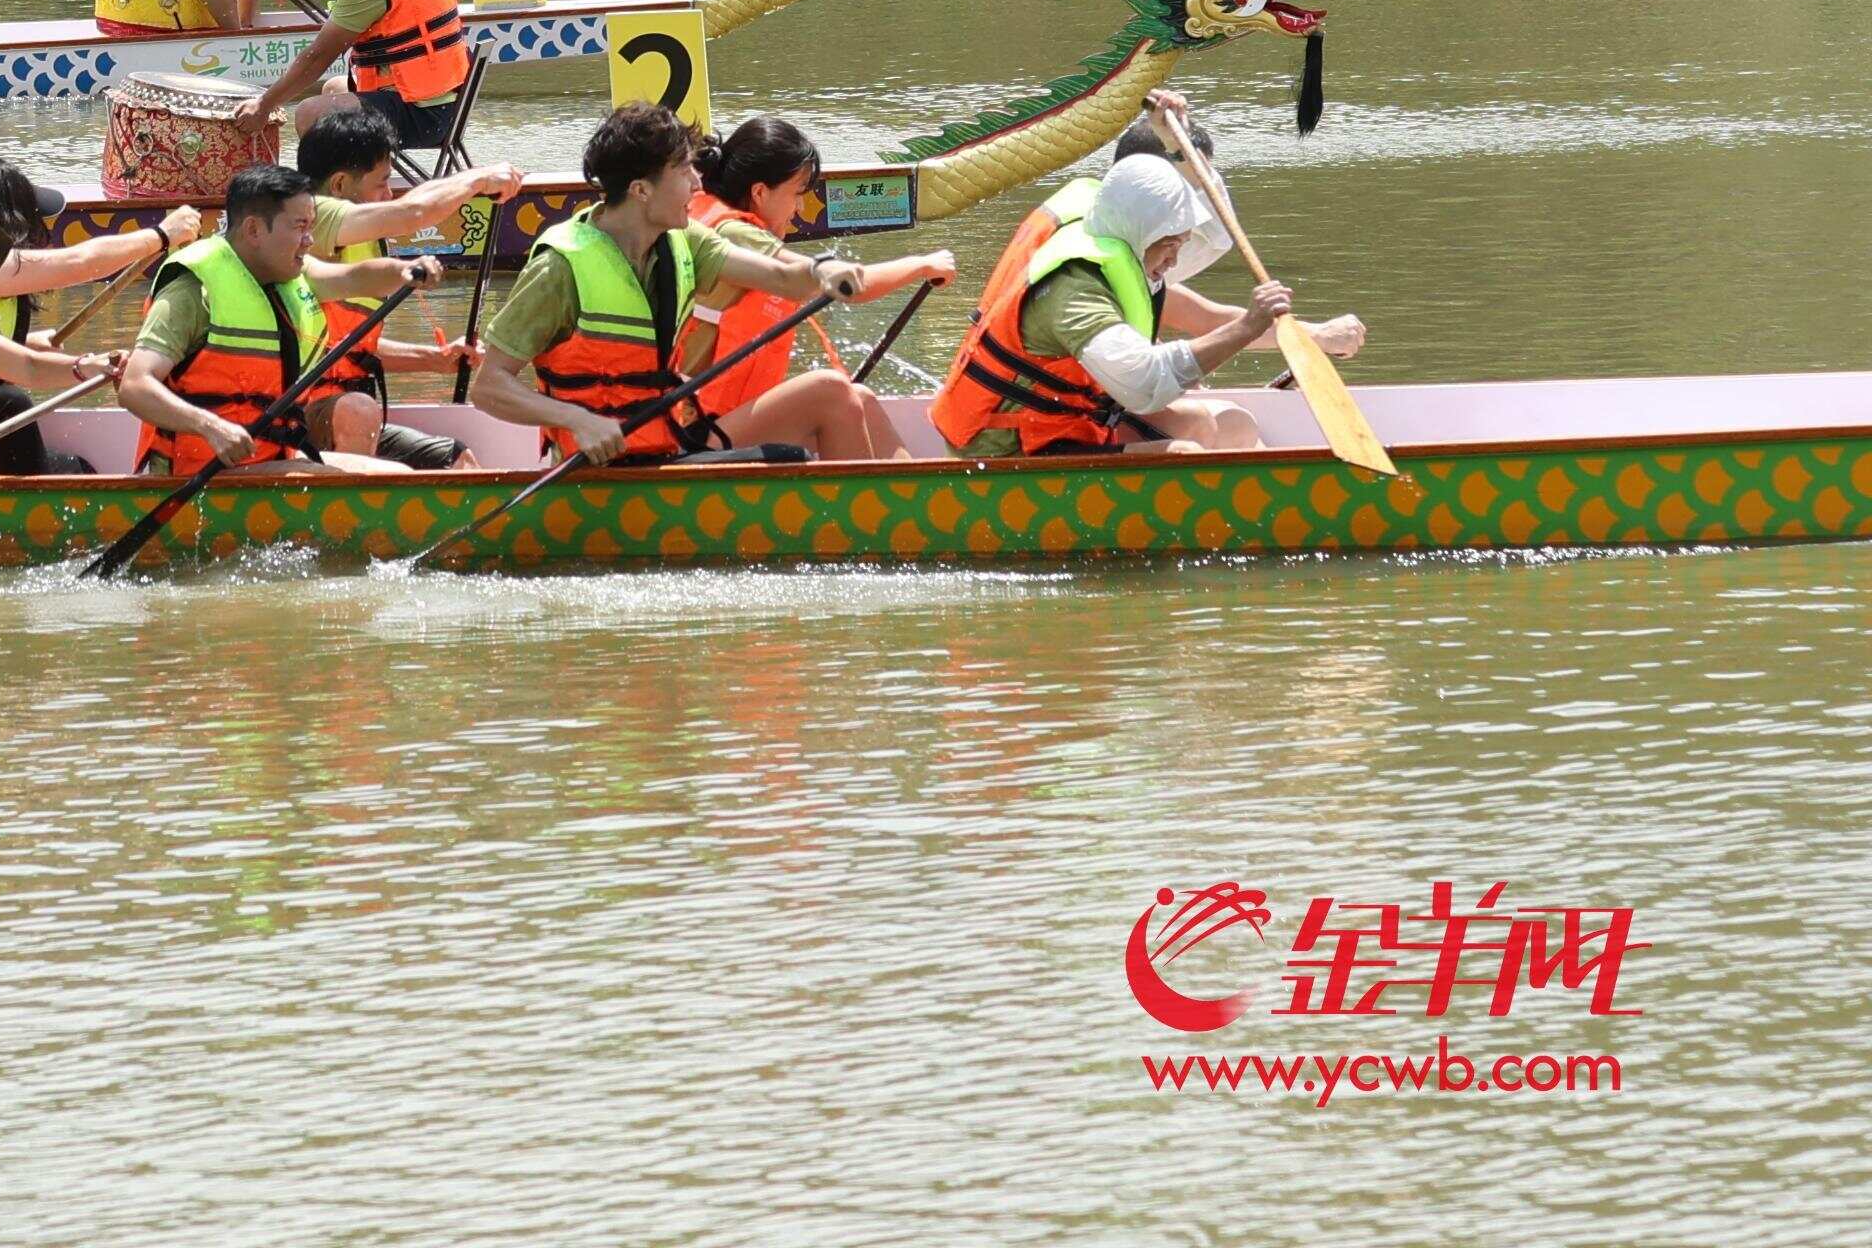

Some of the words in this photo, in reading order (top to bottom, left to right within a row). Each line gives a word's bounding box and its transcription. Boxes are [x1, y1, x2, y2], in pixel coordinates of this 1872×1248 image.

[239, 69, 266, 79] SHUI
[618, 32, 693, 113] 2
[854, 182, 885, 197] 友联
